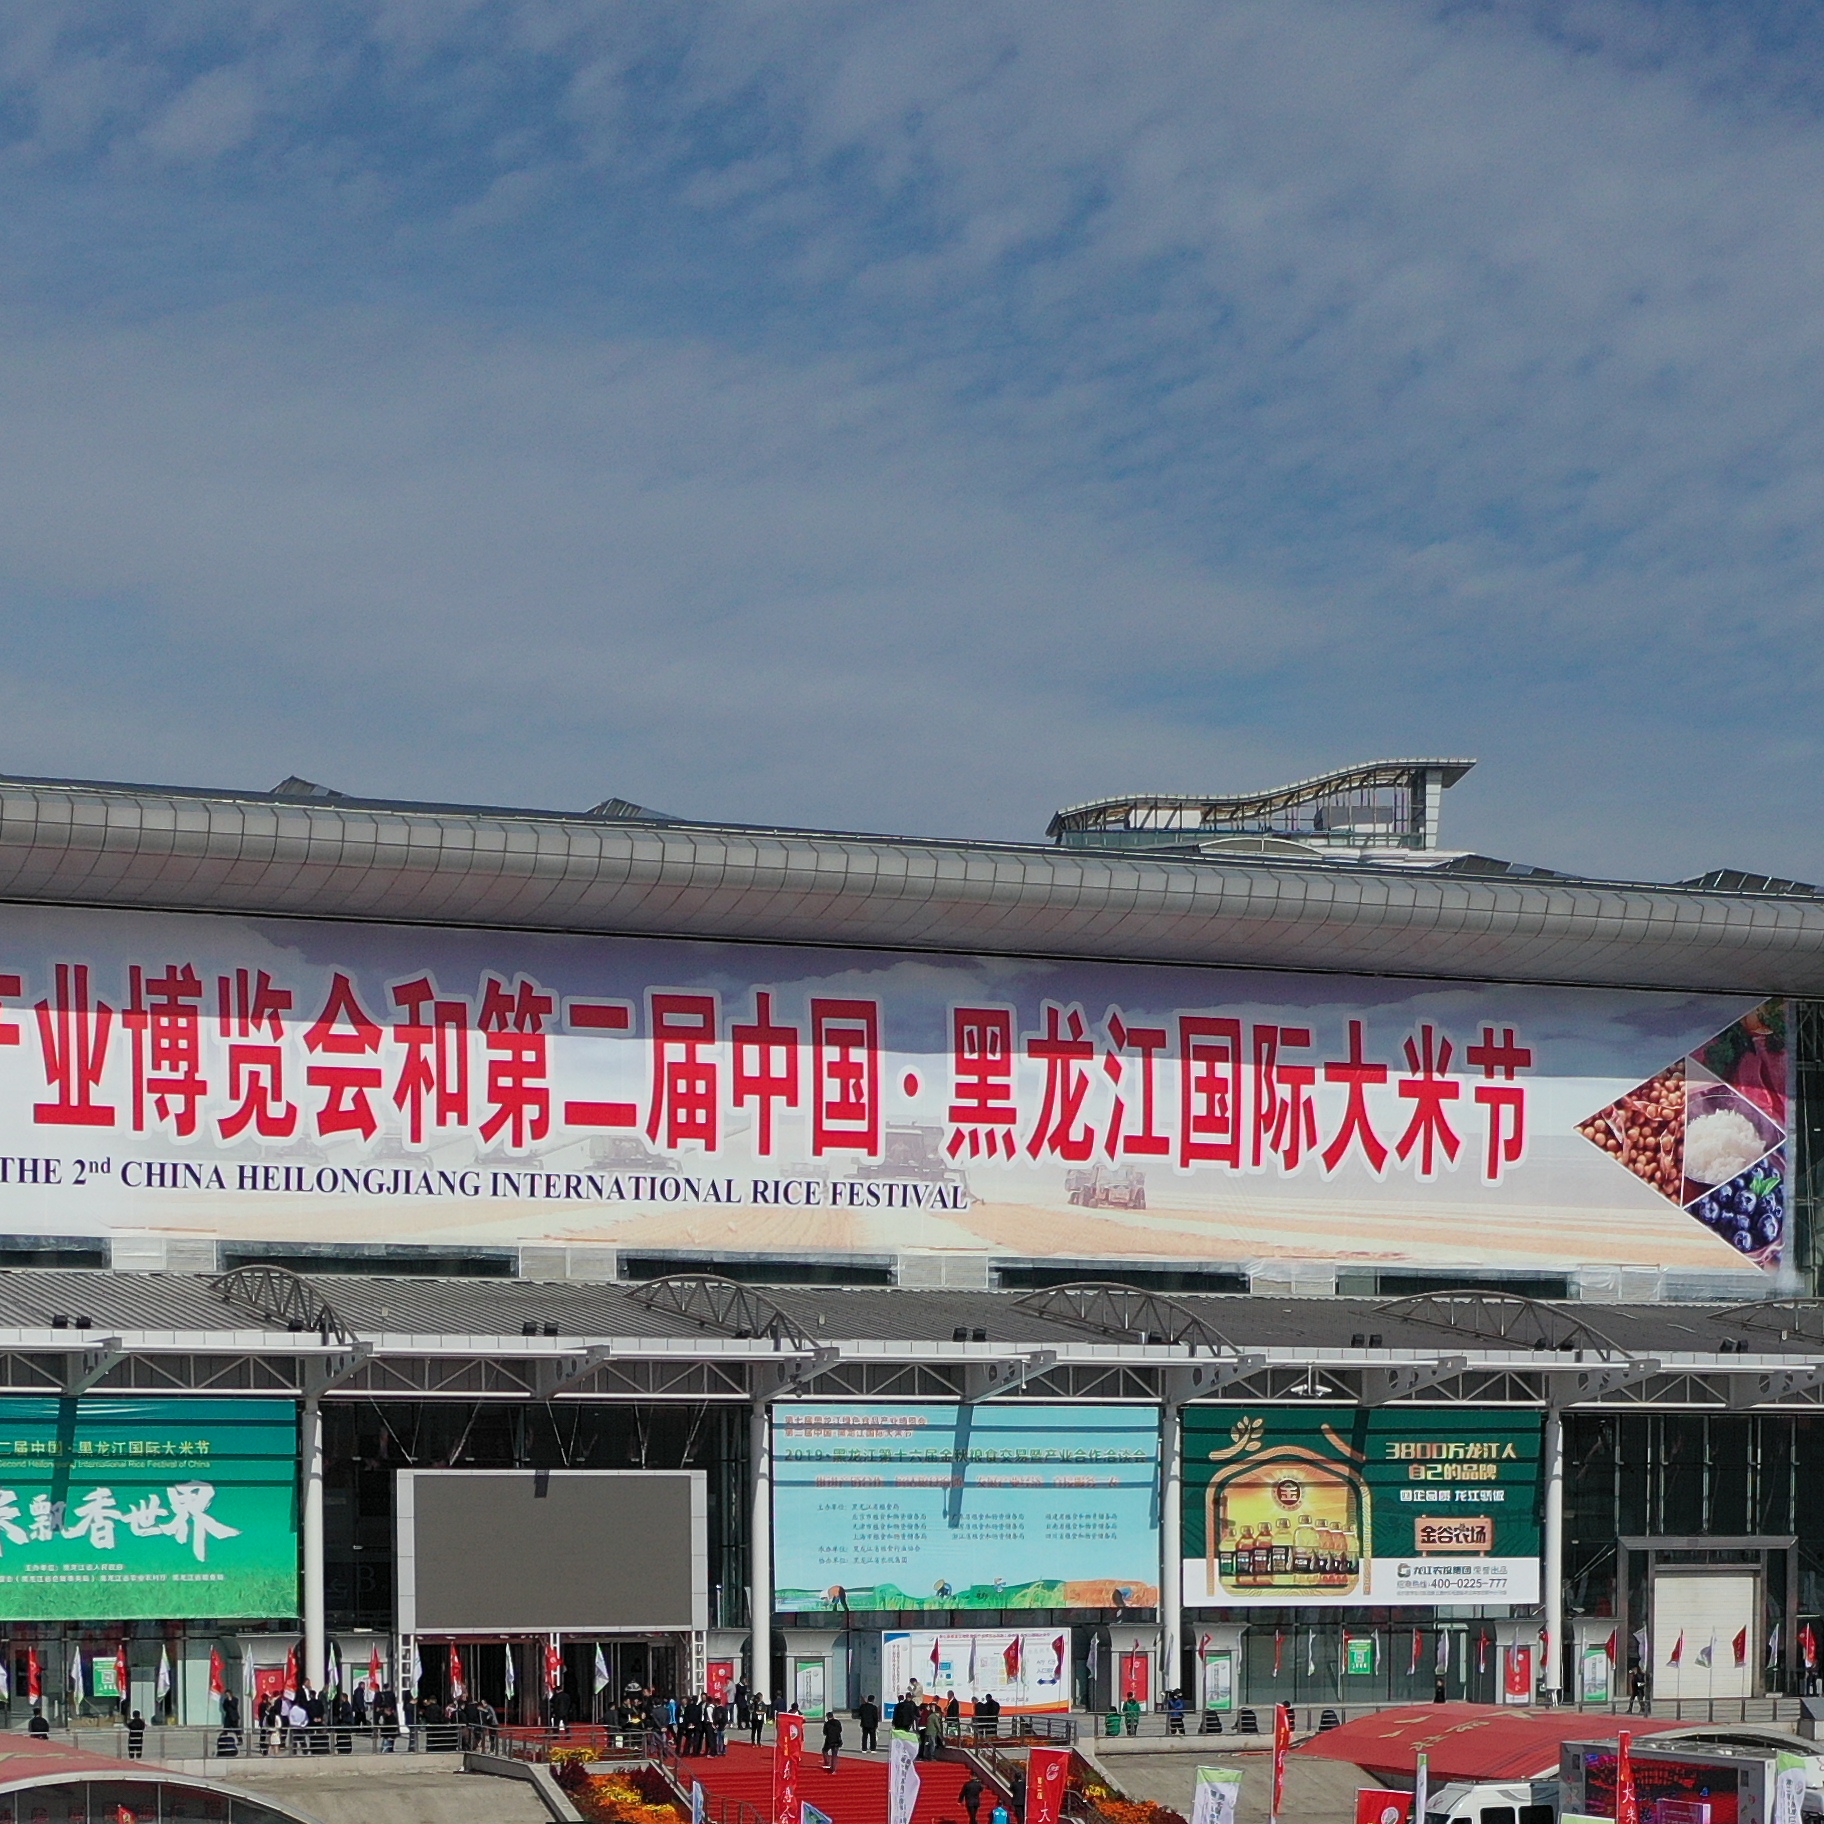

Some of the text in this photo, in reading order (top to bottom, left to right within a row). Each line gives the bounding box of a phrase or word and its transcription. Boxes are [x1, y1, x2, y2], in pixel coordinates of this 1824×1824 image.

[73, 1156, 112, 1187] 2nd
[120, 1161, 225, 1191] CHINA
[236, 1164, 481, 1199] HEILONGJIANG
[491, 1171, 740, 1204] INTERNATIONAL
[750, 1179, 820, 1206] RICE
[831, 1181, 967, 1210] FESTIVAL
[1385, 1442, 1517, 1460] 3800万龙江人
[128, 1459, 145, 1468] Rice
[147, 1459, 177, 1468] Festival
[187, 1459, 211, 1468] China
[1408, 1464, 1497, 1481] 自己的品牌
[1420, 1524, 1486, 1545] 金谷农场
[1431, 1578, 1508, 1589] 400-0225-777
